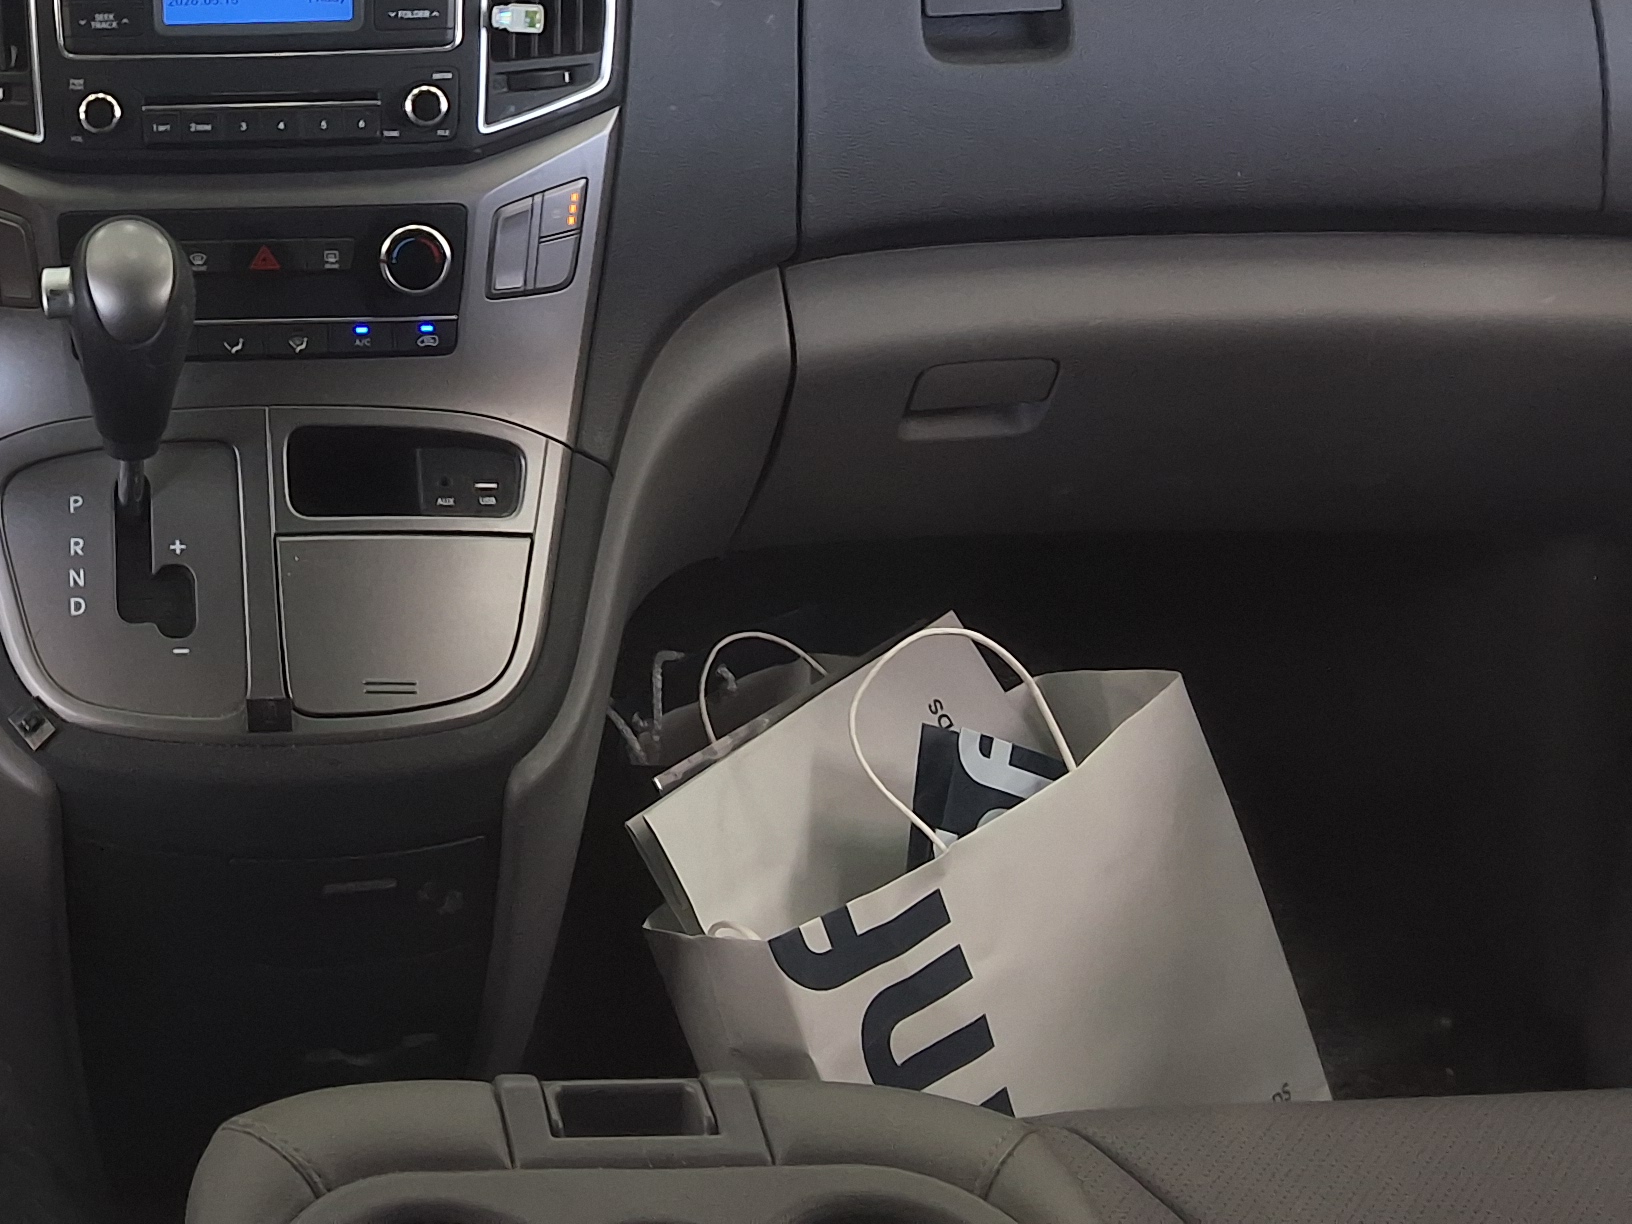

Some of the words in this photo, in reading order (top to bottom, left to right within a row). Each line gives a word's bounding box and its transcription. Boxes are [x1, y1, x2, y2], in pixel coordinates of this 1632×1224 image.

[70, 496, 84, 514] P
[436, 497, 455, 506] AUX
[70, 538, 84, 556] R
[70, 569, 85, 587] N
[70, 598, 86, 616] D
